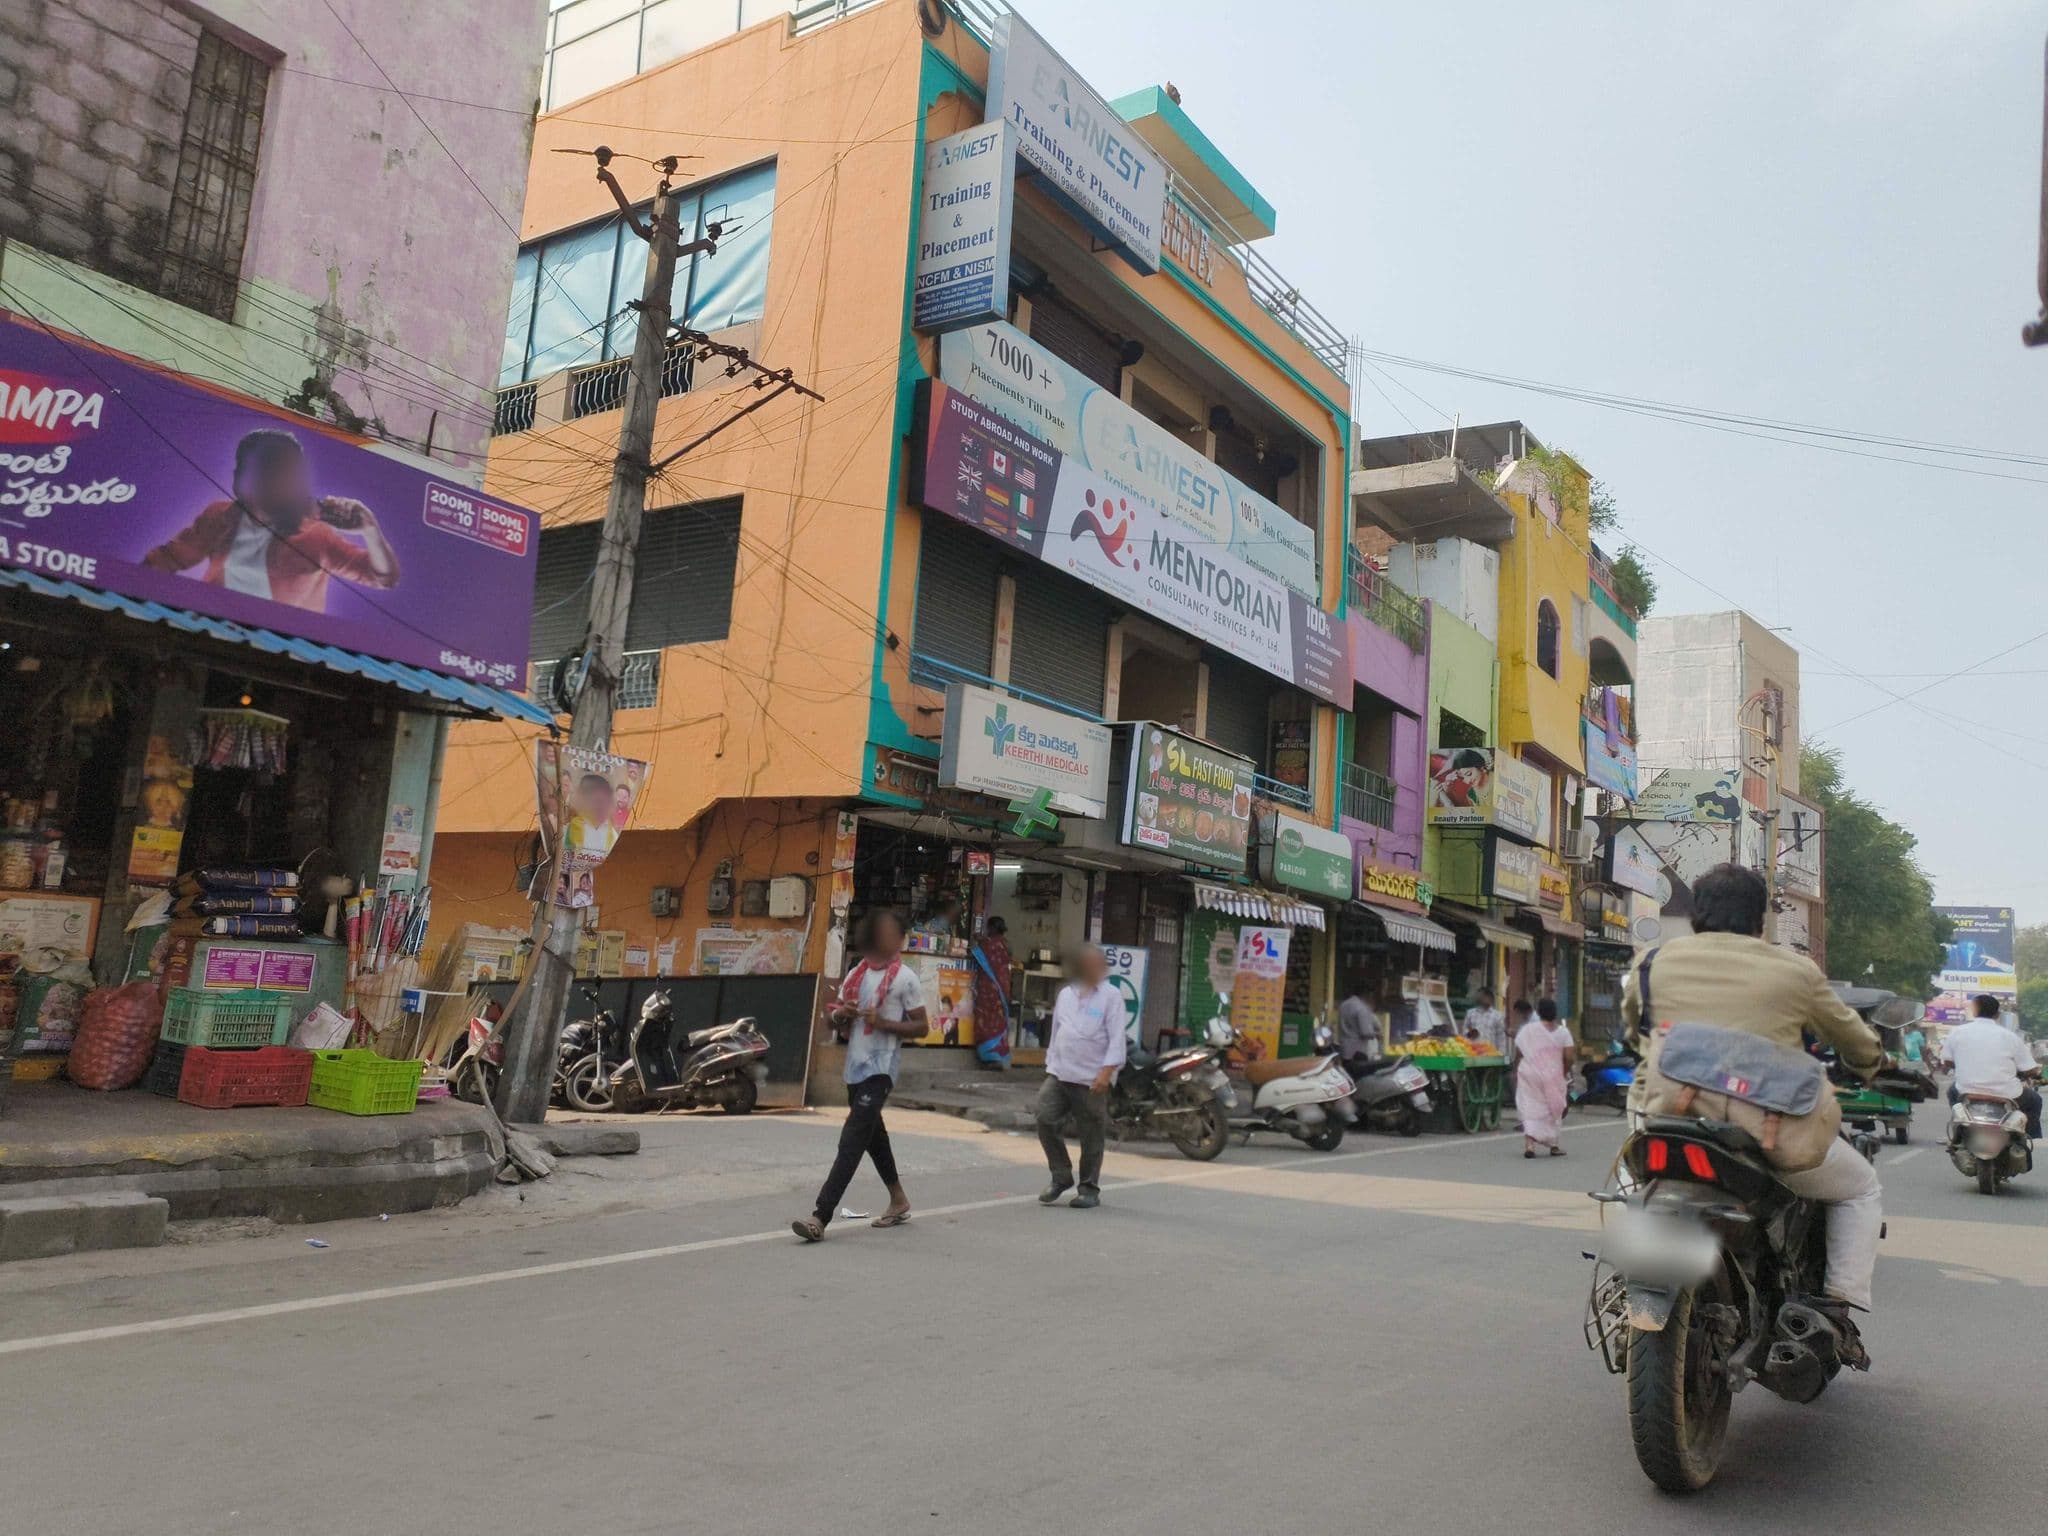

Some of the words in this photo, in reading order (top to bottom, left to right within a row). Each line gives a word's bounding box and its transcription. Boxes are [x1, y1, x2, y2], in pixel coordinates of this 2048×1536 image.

[1013, 102, 1074, 175] Training
[1076, 165, 1086, 183] &
[1089, 173, 1152, 240] Placement
[1017, 137, 1058, 179] 7-2229333
[929, 181, 992, 212] Training
[952, 213, 963, 229] &
[921, 226, 994, 261] Placement
[1161, 220, 1214, 288] OMPLEX
[917, 270, 950, 289] NCFM
[952, 267, 962, 279] &
[964, 258, 996, 277] NISM
[986, 329, 1033, 382] 7000
[1039, 368, 1052, 390] +
[970, 362, 1025, 405] Placements
[1026, 395, 1043, 416] Till
[1044, 408, 1066, 430] Date
[950, 399, 979, 422] STUDY
[980, 416, 1013, 442] ABROAD
[1013, 436, 1030, 453] AND
[1031, 445, 1054, 467] WORK
[430, 489, 476, 516] 200ML
[482, 507, 525, 533] 500ML
[1262, 521, 1276, 540] Job
[16, 541, 98, 580] STORE
[1149, 528, 1281, 635] MENTORIAN
[1148, 575, 1210, 617] CONSULTANCY
[1213, 610, 1247, 637] SERVICES
[1306, 604, 1332, 640] 100%
[1004, 743, 1044, 765] KEERTHI
[1045, 756, 1089, 776] MEDICALS
[1166, 738, 1191, 777] SL
[1191, 757, 1214, 784] FAST
[1213, 763, 1235, 791] FOOD
[1434, 815, 1458, 823] Beauty
[1459, 815, 1485, 823] Parlour
[1251, 930, 1279, 958] SL
